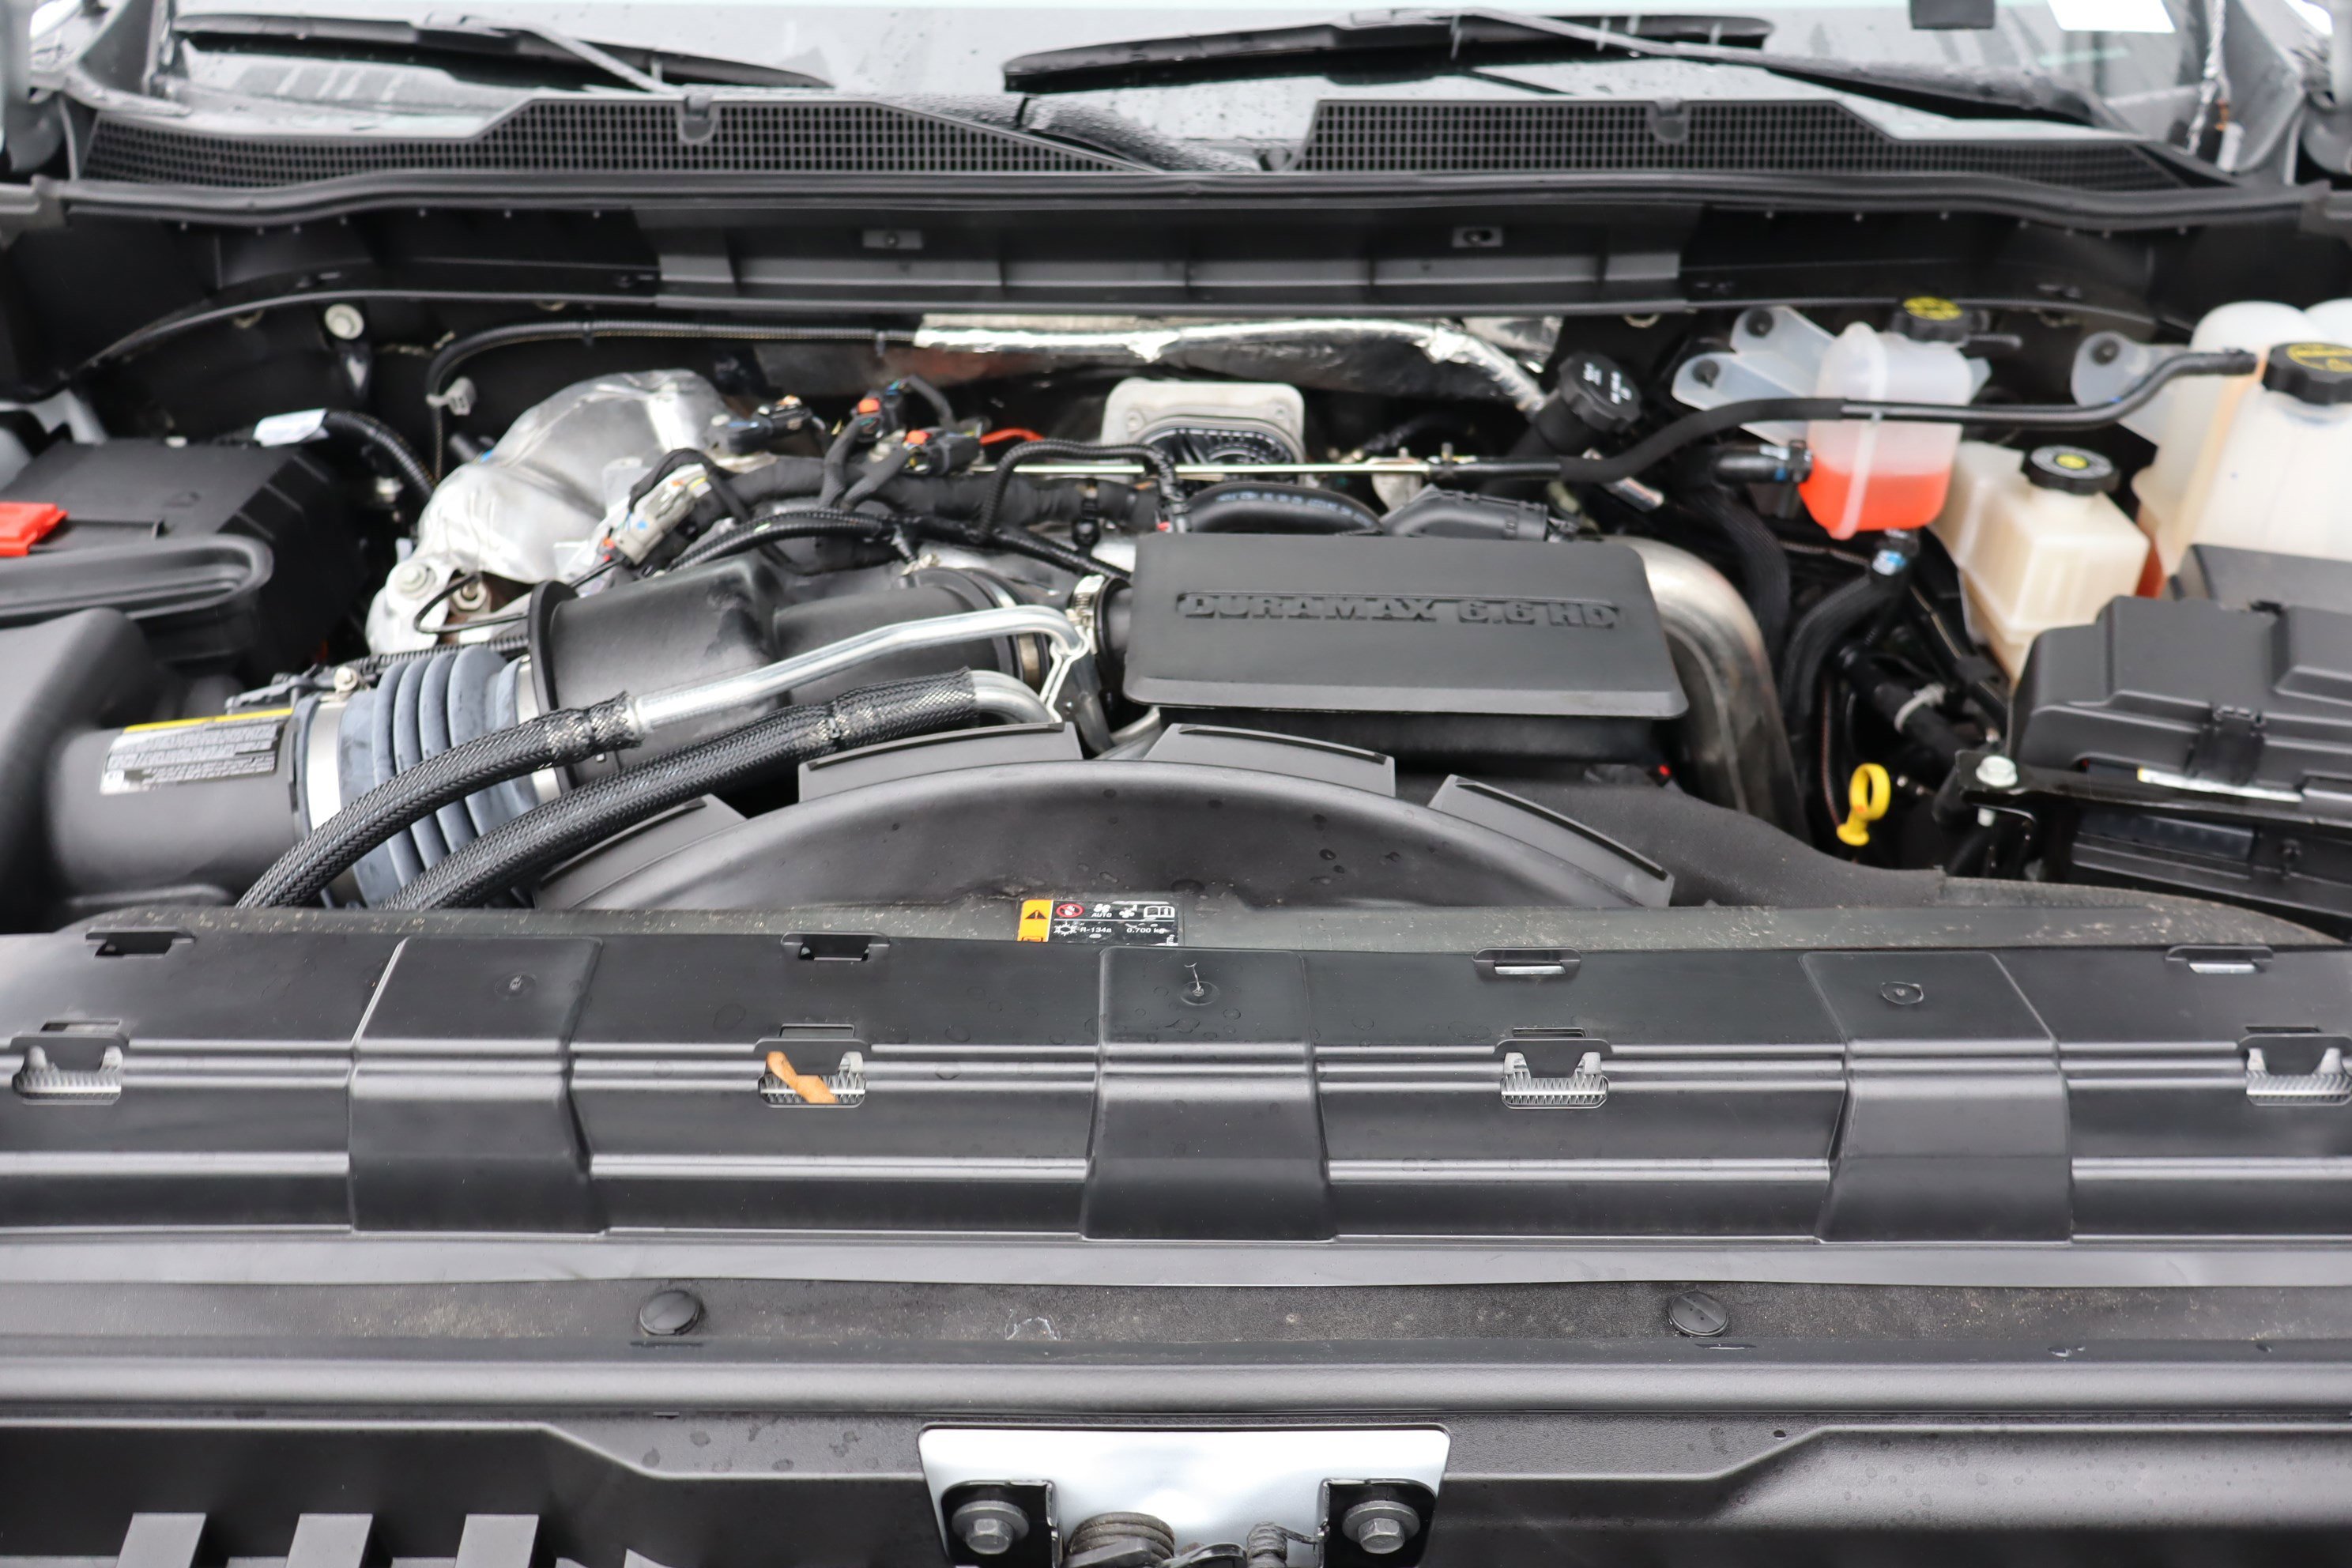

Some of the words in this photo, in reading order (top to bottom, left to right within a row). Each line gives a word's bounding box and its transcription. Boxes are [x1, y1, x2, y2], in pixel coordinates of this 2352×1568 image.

[1183, 594, 1438, 623] DURAMAX
[1457, 598, 1536, 625] 6.6
[1547, 602, 1617, 629] HD
